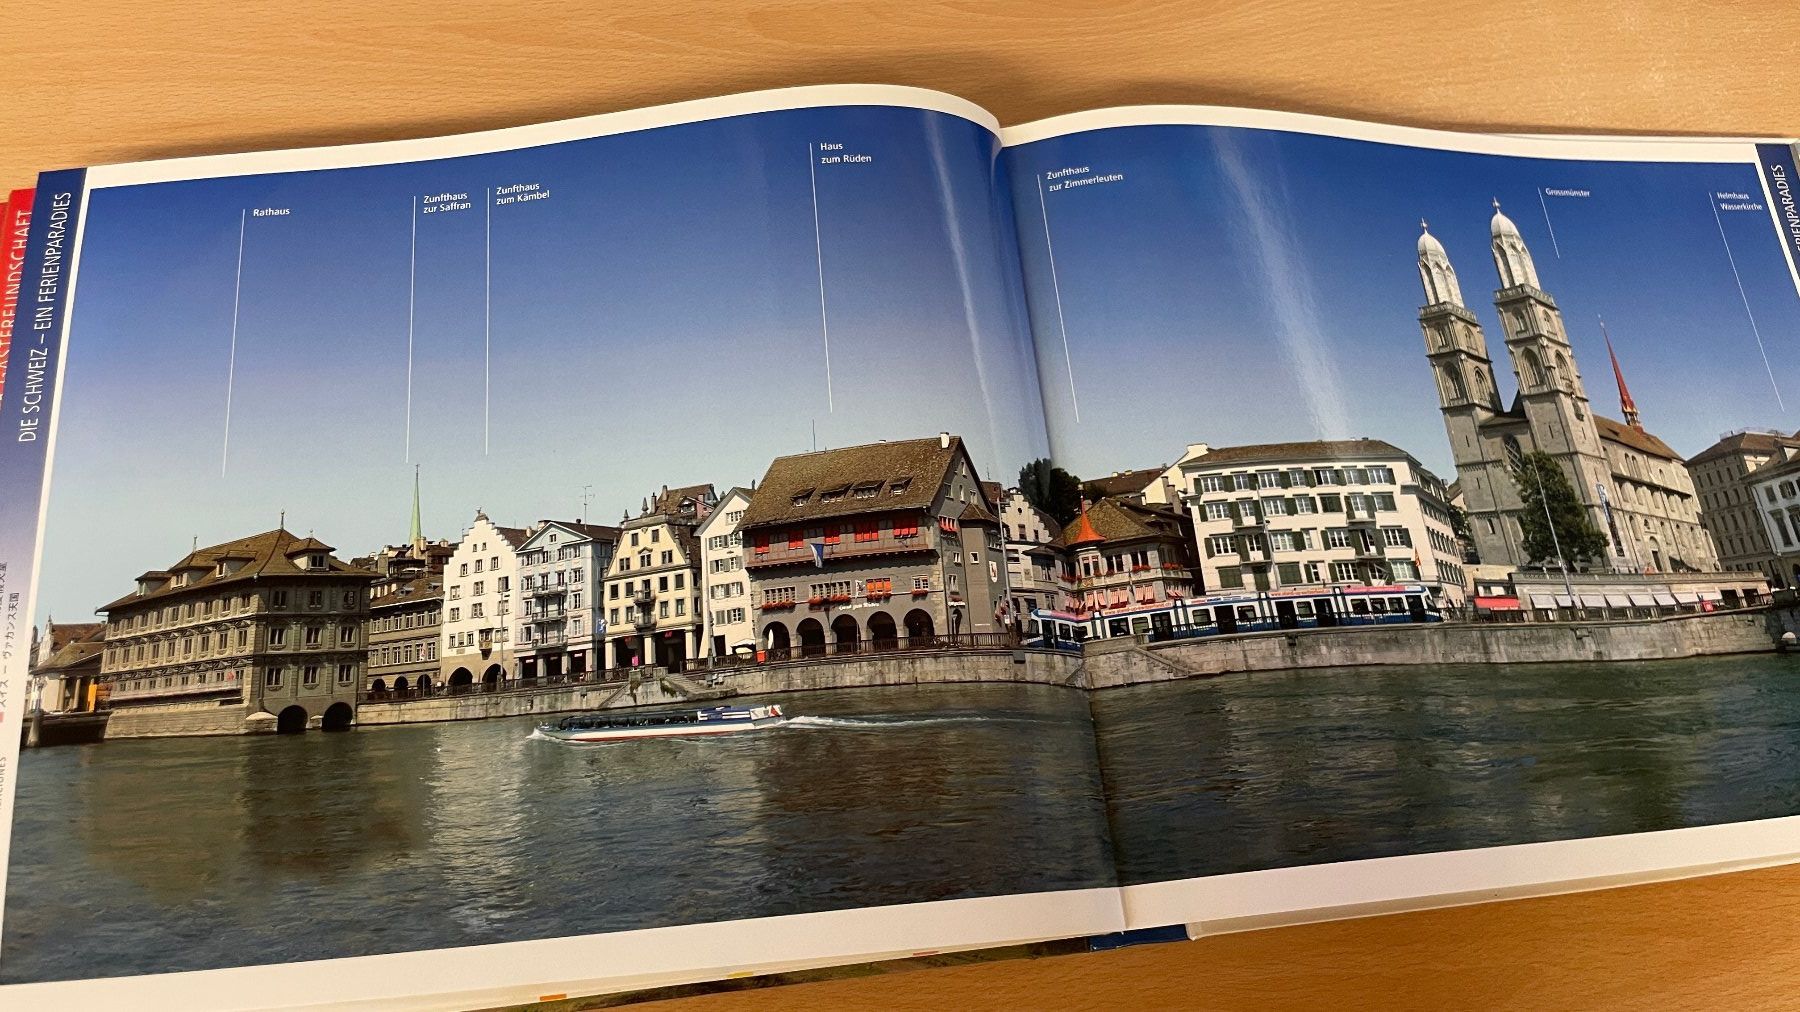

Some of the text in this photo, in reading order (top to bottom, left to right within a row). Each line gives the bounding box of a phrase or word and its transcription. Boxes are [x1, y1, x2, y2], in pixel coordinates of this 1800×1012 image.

[820, 141, 843, 151] Haus
[821, 152, 872, 164] zum Rüden
[1047, 165, 1089, 180] Zunfthaus
[496, 182, 540, 195] Zunfthaus
[1049, 172, 1123, 192] zur Zimmerleuten
[424, 192, 467, 204] Zunfthaus
[496, 190, 550, 206] zum Kämbel
[1545, 187, 1590, 198] Grossmünster
[253, 207, 290, 217] Rathaus
[424, 201, 471, 214] zur Saffran
[1720, 202, 1763, 211] Wasserkirche
[38, 191, 71, 303] FERIENPARADIES
[34, 306, 52, 330] EIN
[22, 347, 48, 413] SCHWEIZ
[19, 419, 38, 442] DIE
